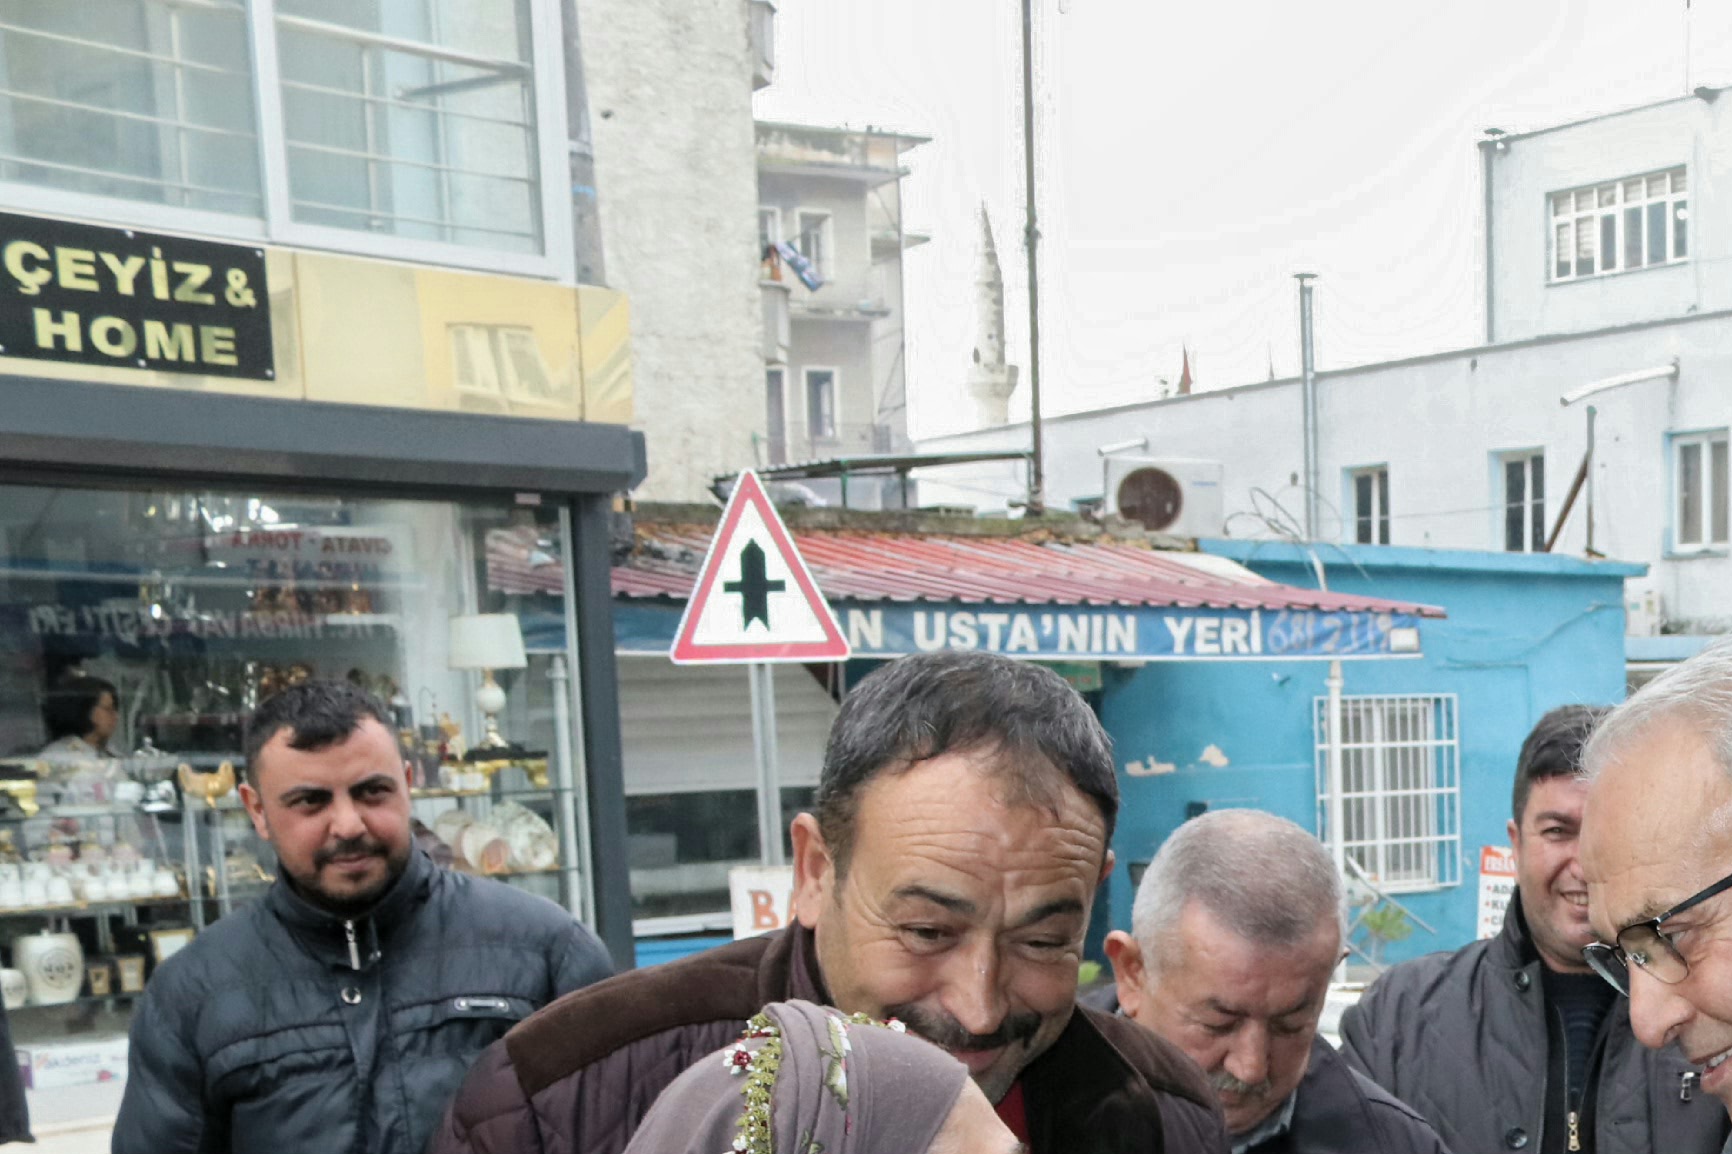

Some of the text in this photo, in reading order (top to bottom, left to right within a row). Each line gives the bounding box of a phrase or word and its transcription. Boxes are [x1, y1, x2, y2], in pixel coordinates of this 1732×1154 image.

[4, 240, 257, 308] ÇEYİZ &
[33, 307, 239, 366] HOME
[840, 609, 883, 649] N
[913, 611, 1137, 653] USTA'NIN
[1163, 610, 1262, 654] YERİ
